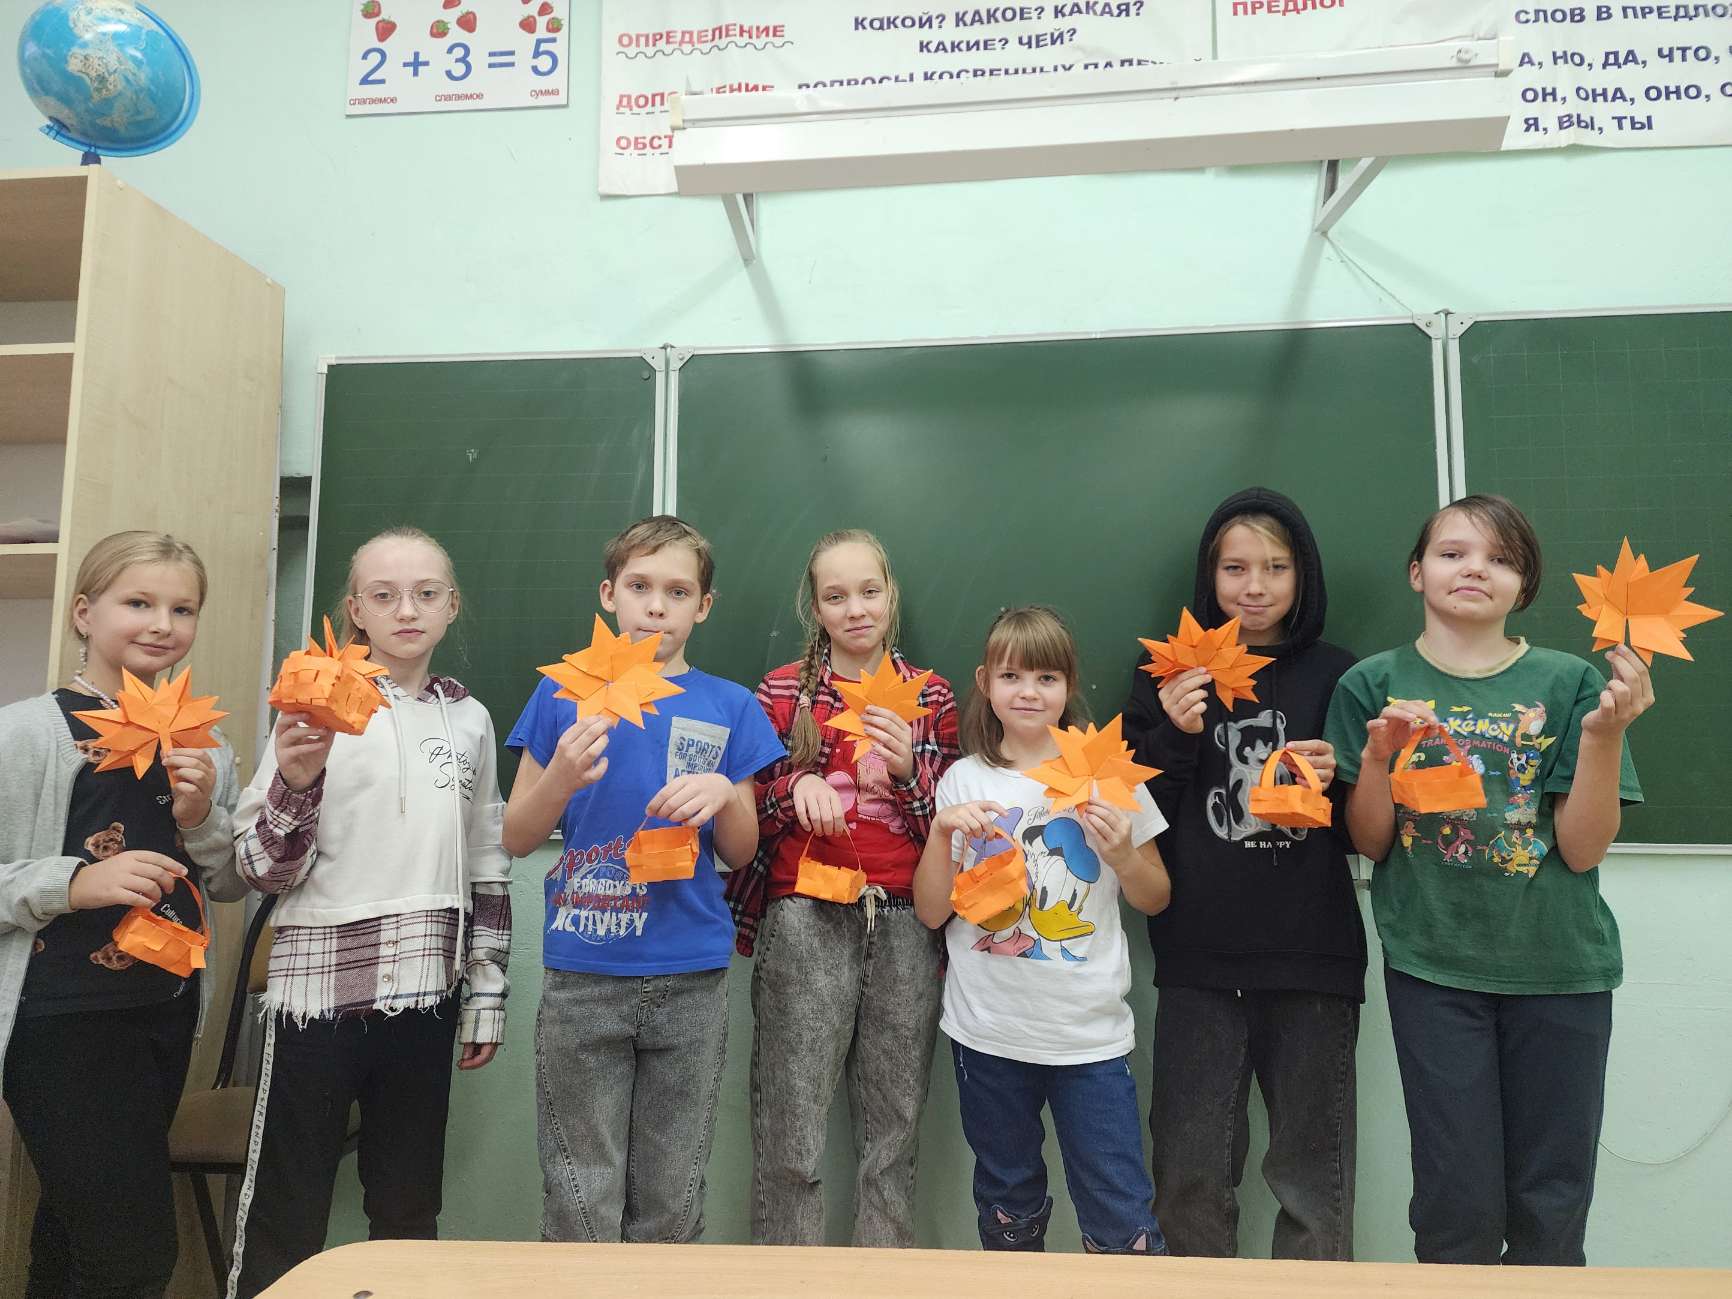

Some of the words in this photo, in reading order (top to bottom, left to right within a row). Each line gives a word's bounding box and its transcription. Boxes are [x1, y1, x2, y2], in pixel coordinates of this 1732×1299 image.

[955, 5, 1045, 28] КАКОЕ?
[1054, 0, 1144, 19] КАКАЯ?
[1514, 7, 1586, 24] СЛОВ
[1596, 5, 1613, 22] В
[1622, 3, 1732, 22] ПРЕДЛО
[617, 23, 786, 48] ОПРЕДЕЛЕНИЕ
[918, 38, 1009, 54] КАКИЕ?
[1018, 28, 1077, 49] ЧЕЙ?
[359, 48, 388, 86] 2
[444, 43, 473, 81] 3
[530, 37, 559, 77] 5
[1518, 51, 1544, 69] А,
[1552, 51, 1594, 71] НО,
[1601, 49, 1648, 70] ДА,
[1657, 45, 1721, 65] ЧТО,
[348, 96, 398, 106] слагаемое
[434, 91, 484, 103] слагаемое
[530, 87, 560, 98] сумма
[1521, 87, 1568, 105] ОН,
[1575, 86, 1635, 105] ОНА,
[1644, 84, 1712, 103] ОНО,
[1523, 116, 1549, 135] Я,
[1557, 113, 1605, 135] ВЫ,
[1611, 115, 1655, 131] ТЫ
[615, 133, 674, 151] ОБСТ
[676, 736, 722, 761] SPORTS
[1244, 840, 1257, 848] BE
[547, 907, 648, 937] ACTIVITY
